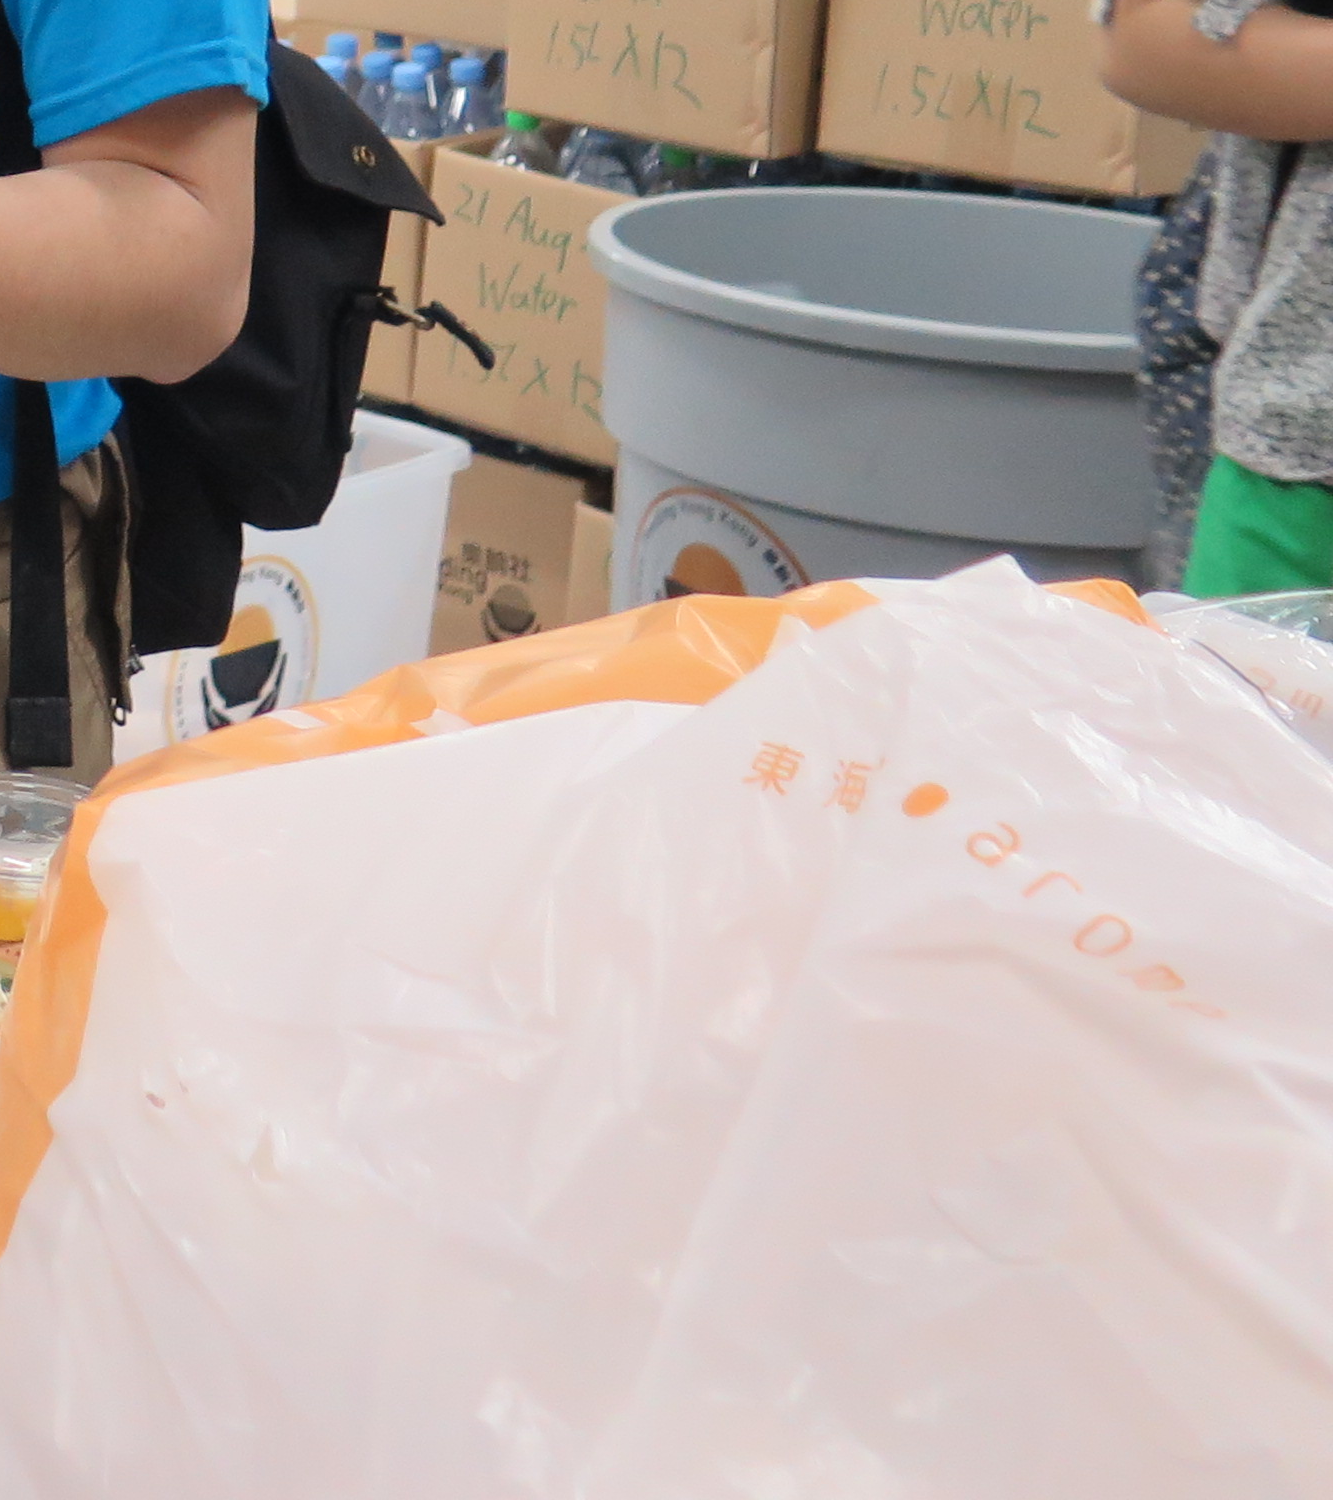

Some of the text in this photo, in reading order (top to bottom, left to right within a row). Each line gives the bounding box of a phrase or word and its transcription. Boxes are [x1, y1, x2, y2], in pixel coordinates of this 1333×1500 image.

[453, 183, 572, 274] 21 Aug
[478, 261, 578, 324] Water
